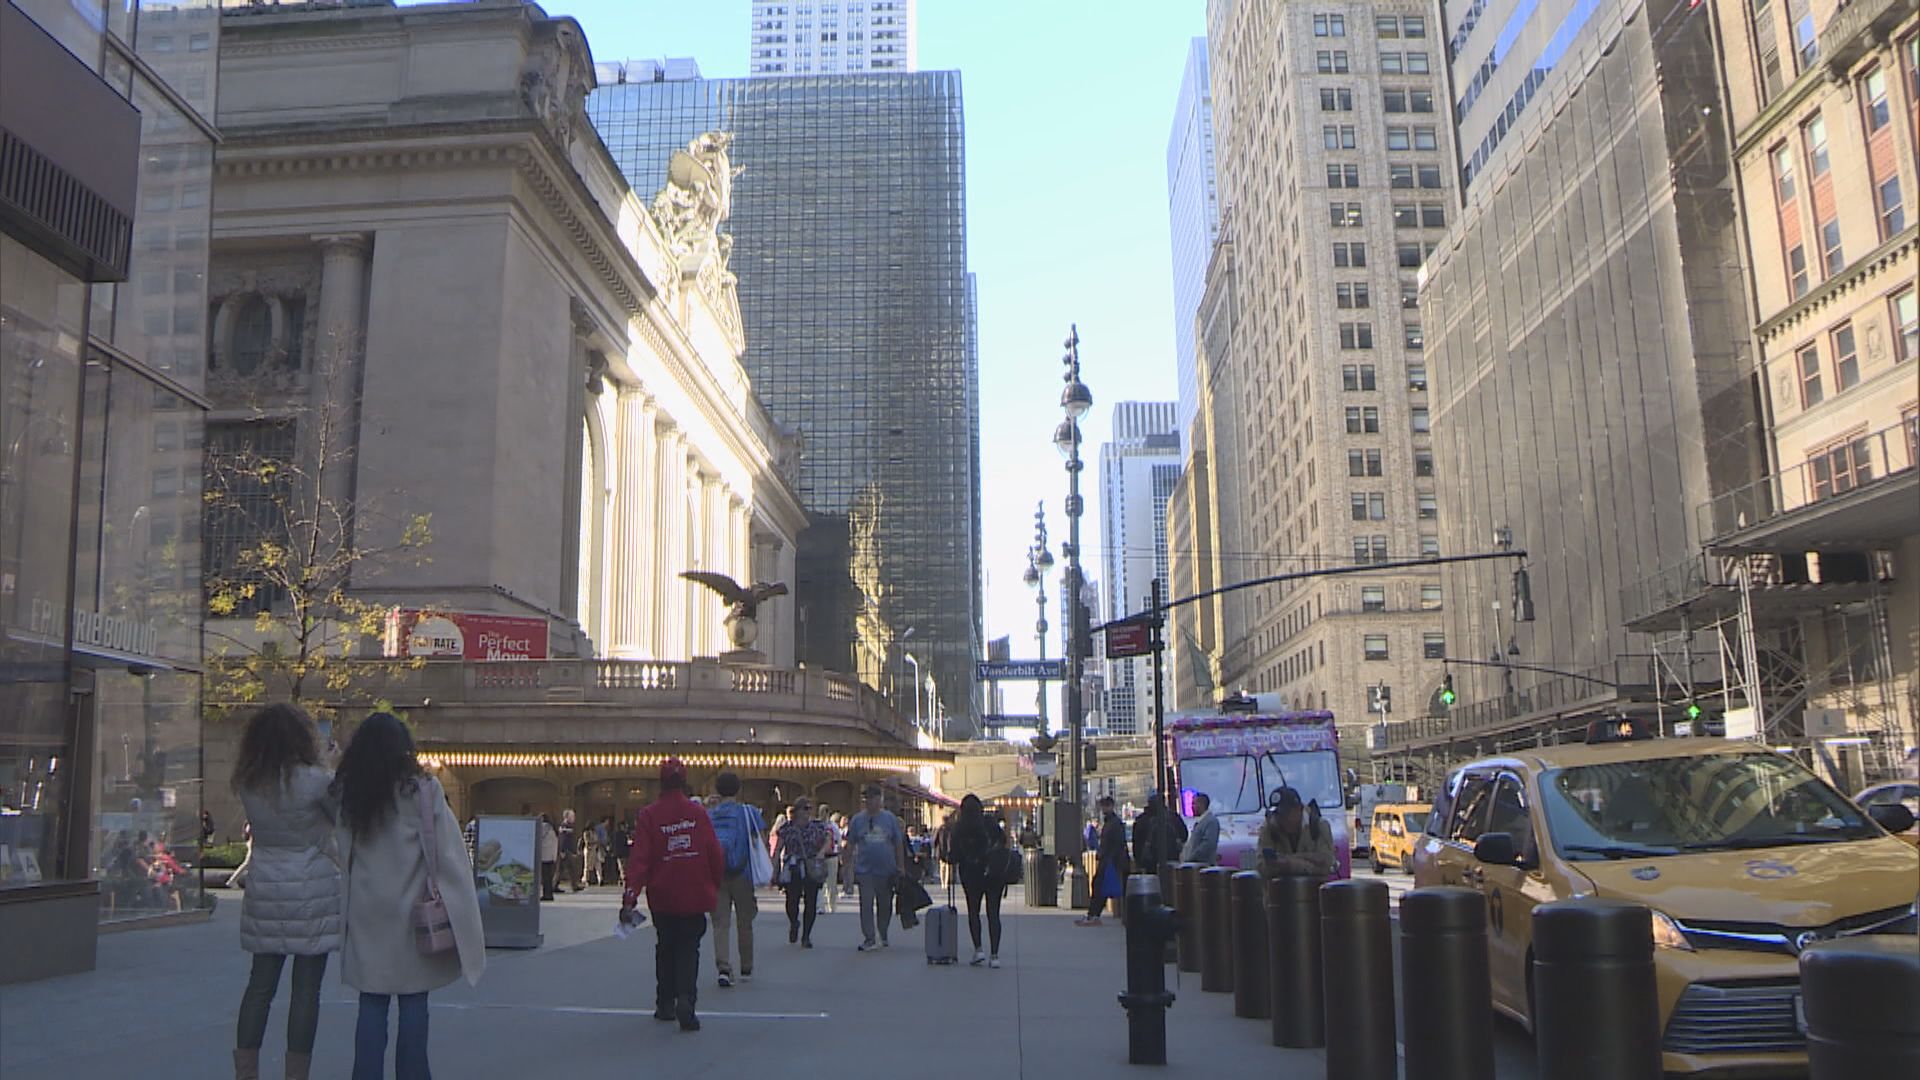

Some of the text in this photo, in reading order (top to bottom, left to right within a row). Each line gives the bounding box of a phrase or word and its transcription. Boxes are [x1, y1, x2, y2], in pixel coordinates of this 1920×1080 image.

[479, 633, 531, 651] Perfect
[981, 664, 1058, 676] Vanderbilt Ave
